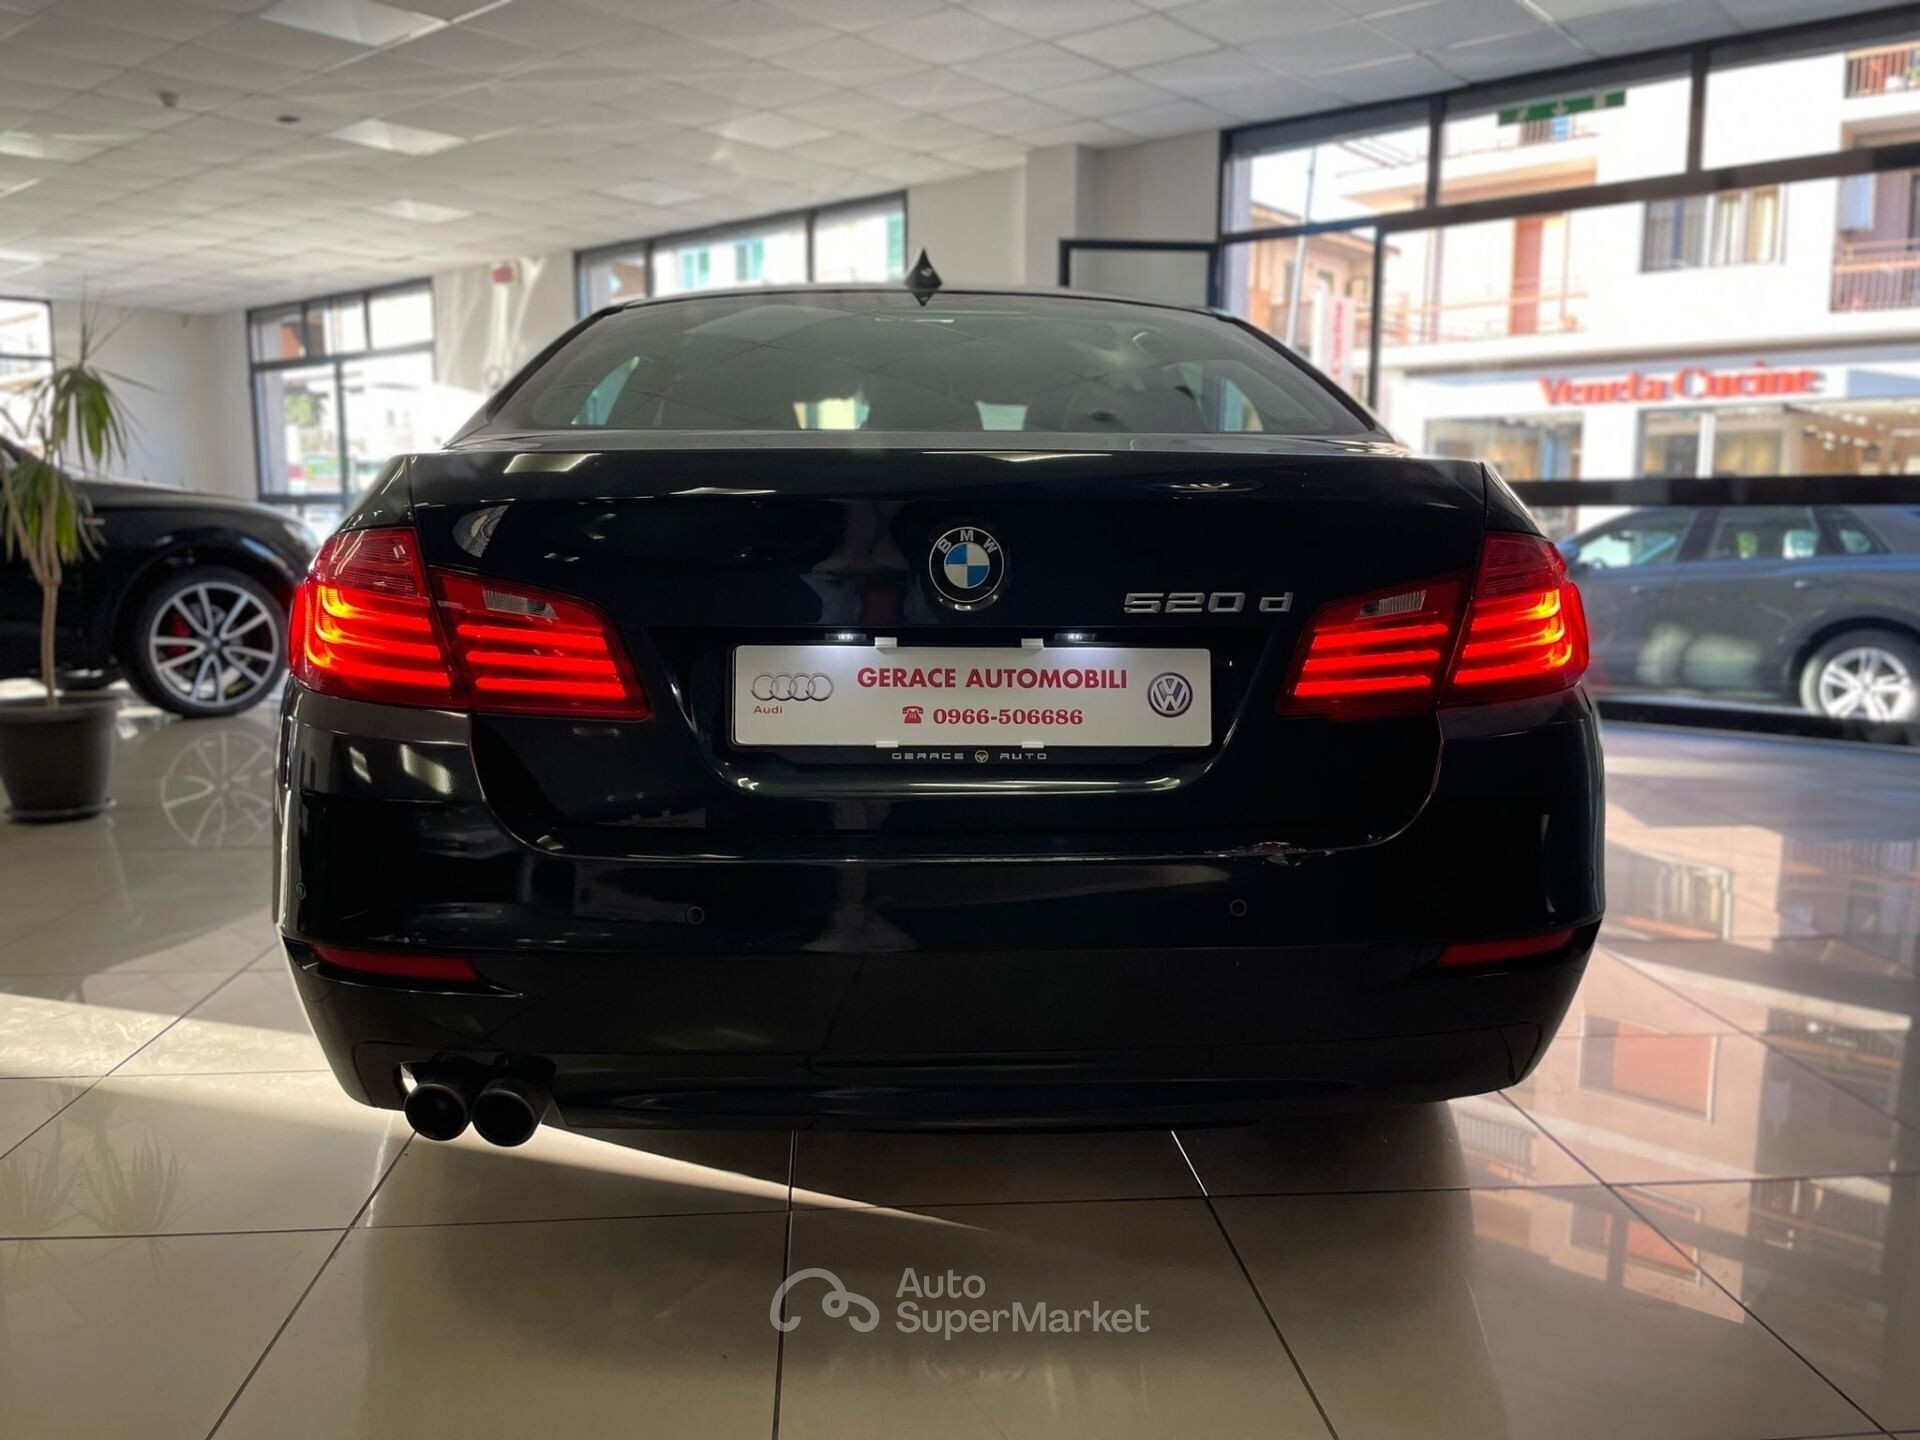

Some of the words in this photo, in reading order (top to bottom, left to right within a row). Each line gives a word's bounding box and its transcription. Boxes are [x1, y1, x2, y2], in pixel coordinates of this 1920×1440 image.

[937, 529, 998, 554] BMW
[1123, 591, 1246, 613] 520
[1258, 591, 1294, 613] d
[857, 667, 956, 689] GERACE
[965, 667, 1128, 689] AUTOMOBILI
[752, 705, 783, 715] Audi
[932, 708, 1083, 725] 0966-506686
[891, 752, 964, 760] GERACE
[999, 752, 1047, 760] AUTO
